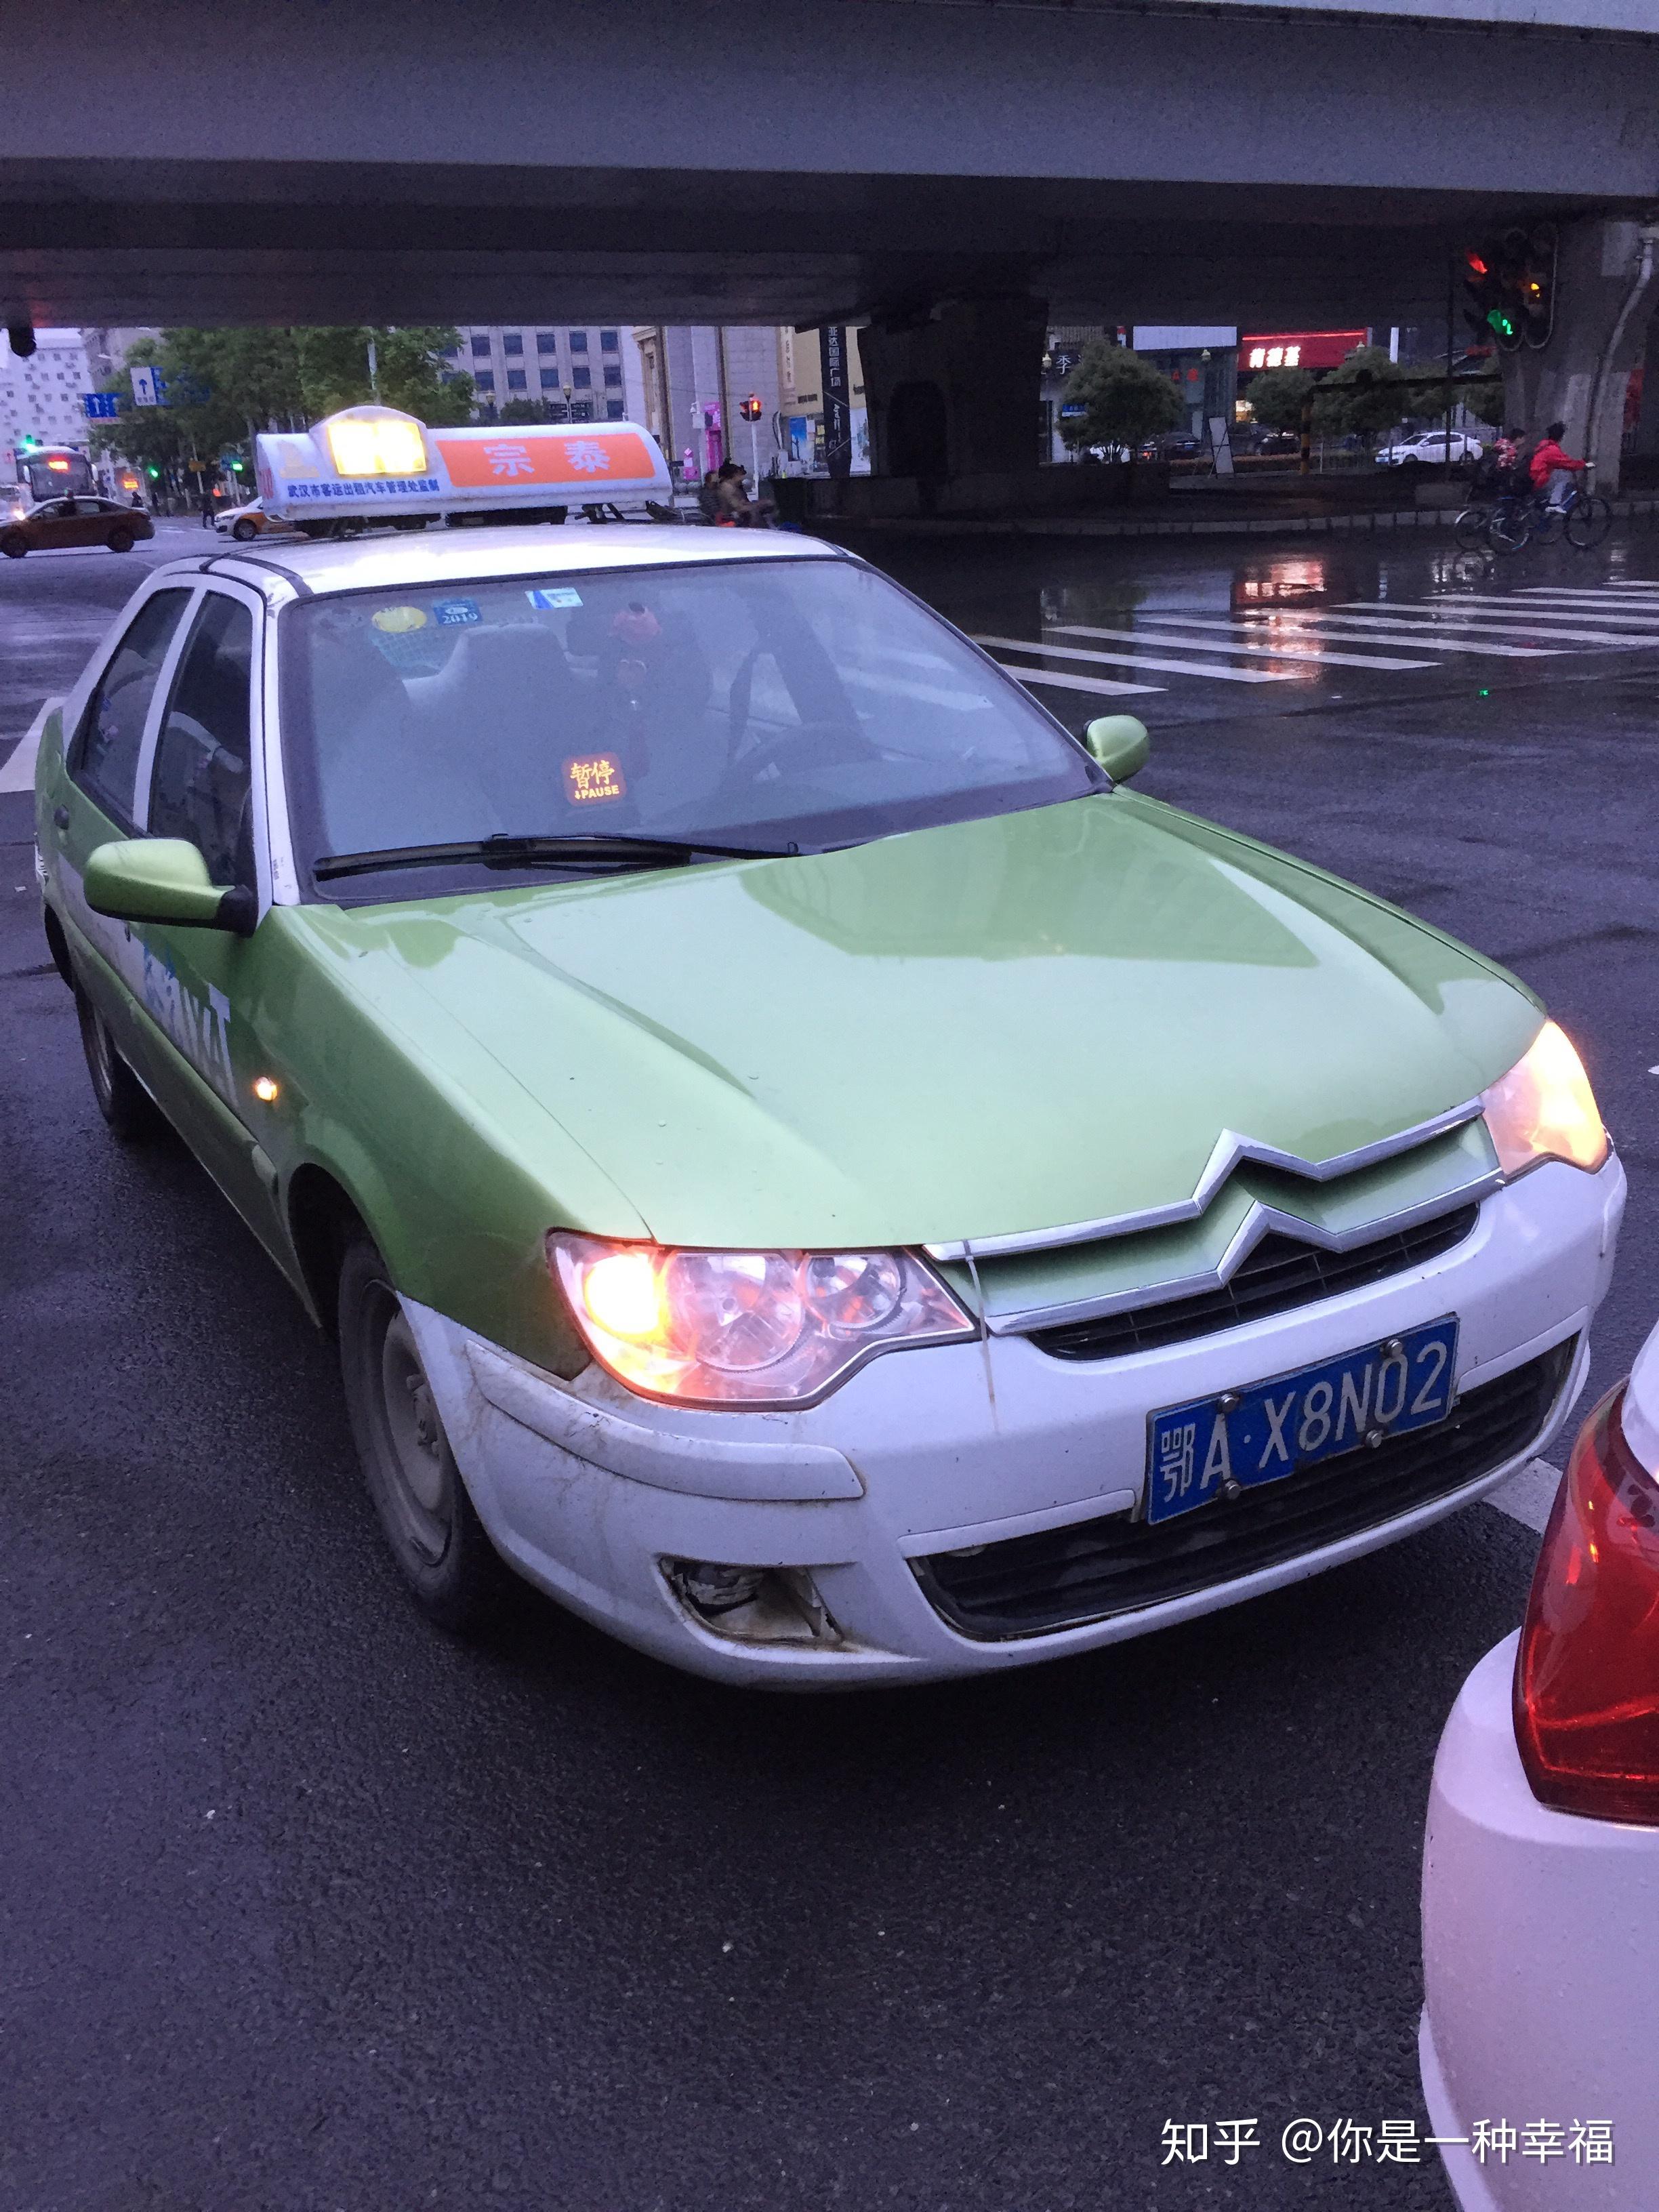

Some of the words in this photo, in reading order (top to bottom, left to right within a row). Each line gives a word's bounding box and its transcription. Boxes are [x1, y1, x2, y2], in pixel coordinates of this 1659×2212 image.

[483, 441, 610, 476] 宗泰
[287, 478, 440, 497] 武汉市客运出租汽车管理处监制
[443, 613, 478, 626] 2019
[570, 760, 615, 789] 暂停
[581, 785, 619, 799] PAUSE
